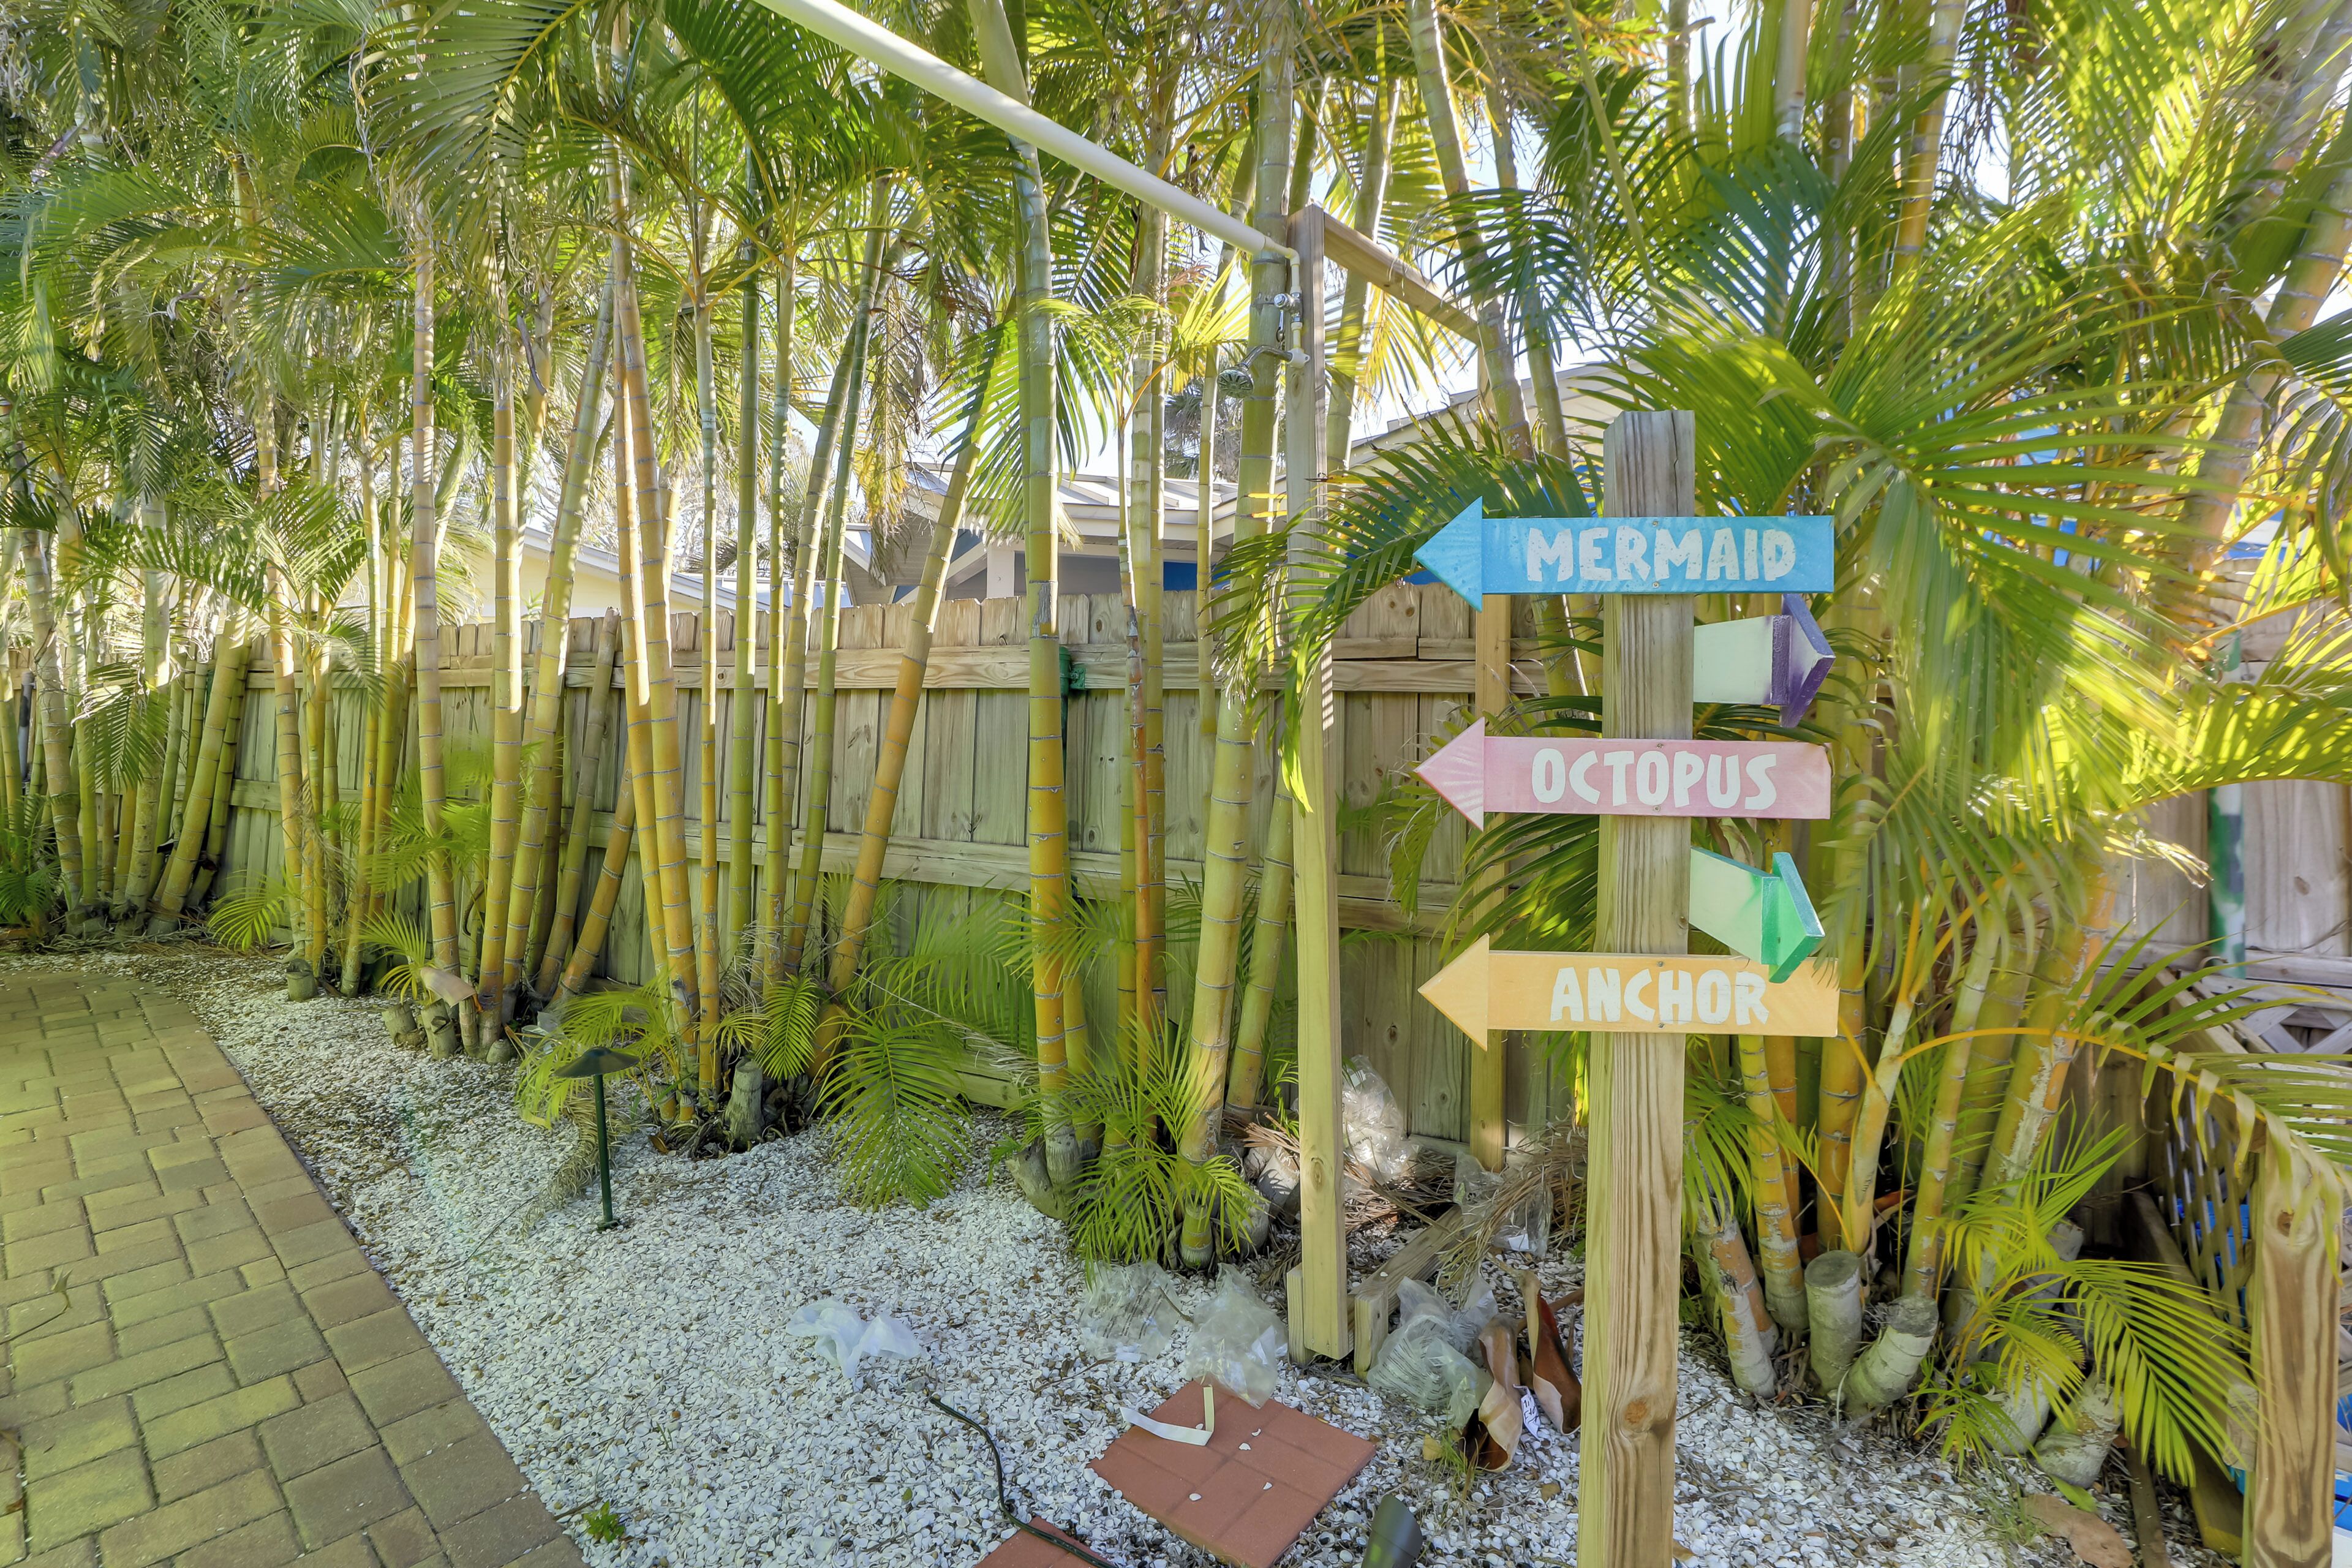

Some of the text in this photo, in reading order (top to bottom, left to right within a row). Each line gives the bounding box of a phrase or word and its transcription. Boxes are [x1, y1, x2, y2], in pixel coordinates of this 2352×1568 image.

[1527, 526, 1796, 582] MERMAID
[1531, 748, 1777, 810] OCTOPUS
[1550, 967, 1770, 1026] ANCHOR
